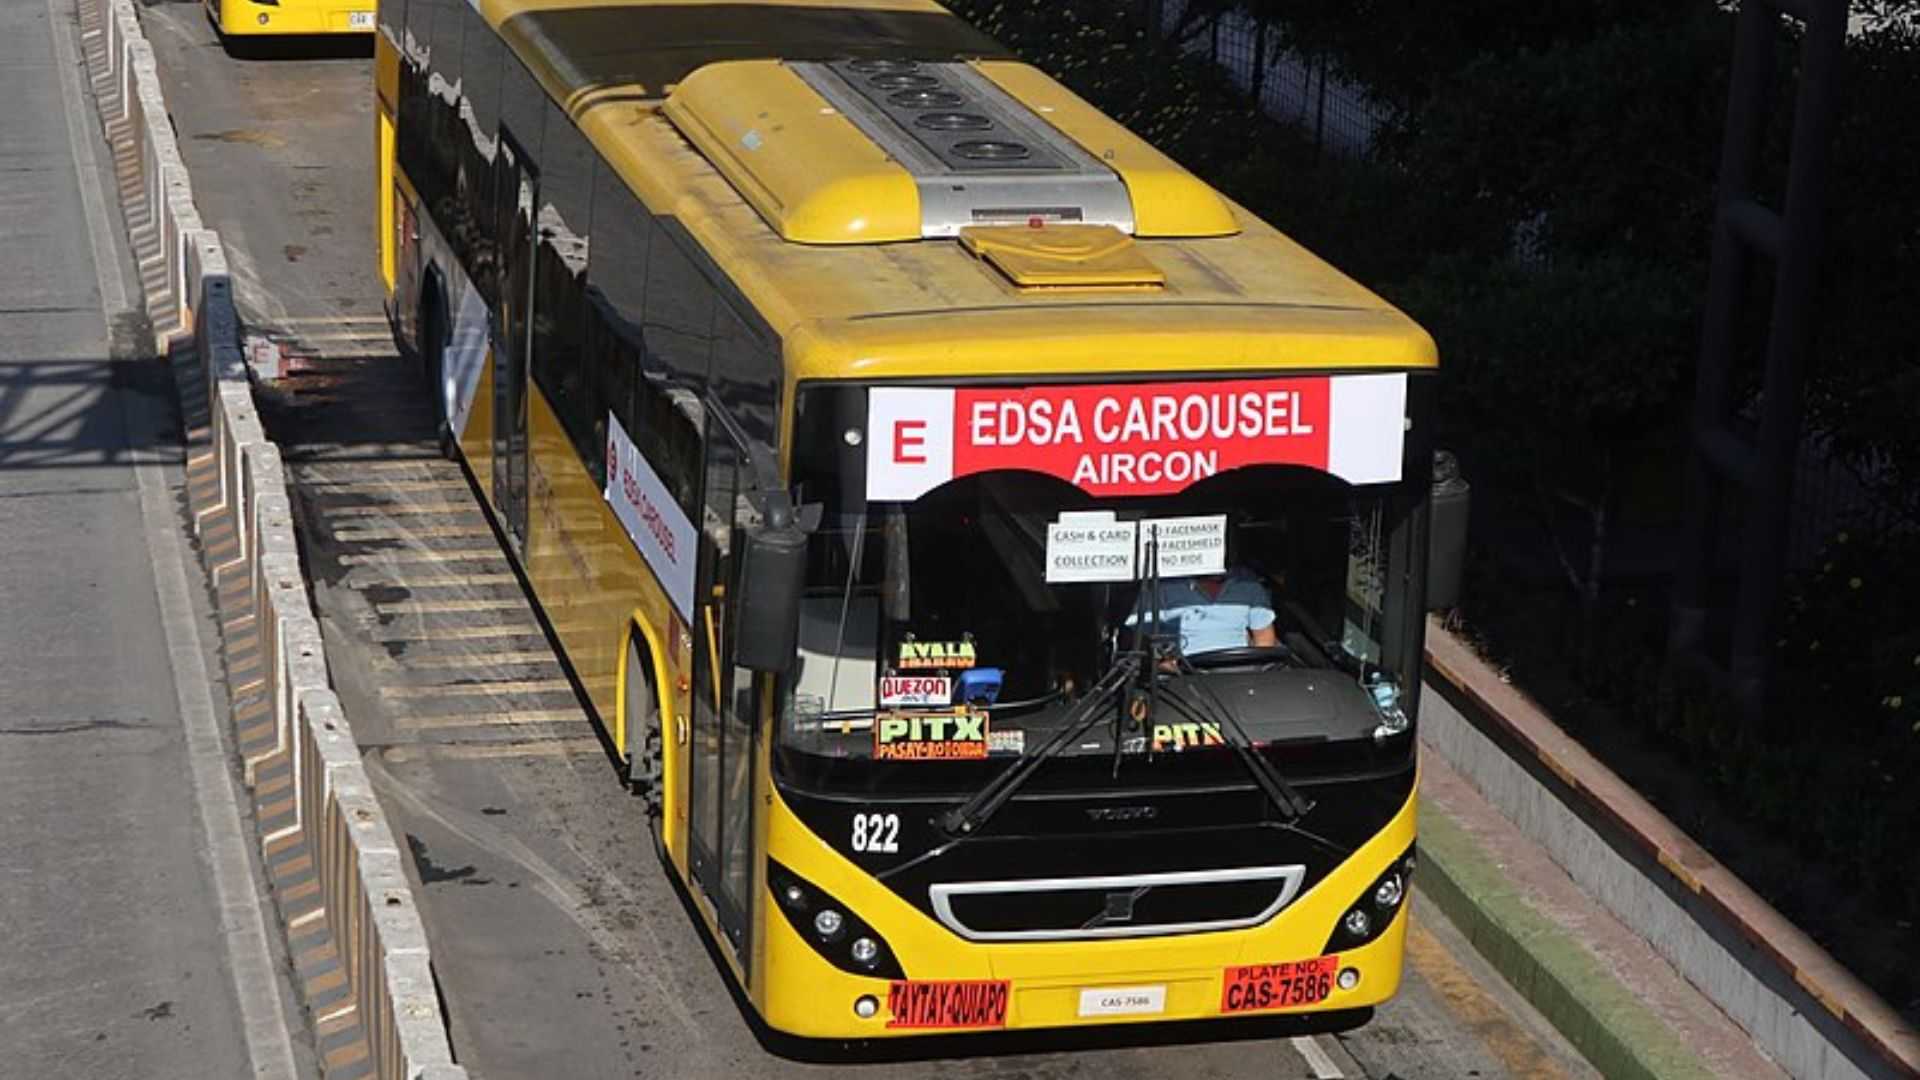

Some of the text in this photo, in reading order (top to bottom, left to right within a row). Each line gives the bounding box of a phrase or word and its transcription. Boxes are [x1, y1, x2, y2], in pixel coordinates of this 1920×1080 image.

[971, 391, 1313, 446] EDSA CAROUSEL
[892, 420, 927, 463] E
[1072, 450, 1217, 485] AIRCON
[1054, 530, 1085, 542] CASH
[1099, 530, 1131, 542] CARD
[1165, 523, 1219, 535] FACEMASK
[1161, 537, 1222, 551] FACESHIELD
[1054, 554, 1129, 568] COLLECTION
[1161, 553, 1203, 566] NO RIDE
[901, 641, 976, 657] AYALA
[882, 679, 946, 698] QUEZON
[880, 717, 984, 743] PITX
[1154, 723, 1224, 747] PITX
[851, 813, 899, 853] 822
[1237, 962, 1290, 981] PLATE
[1227, 972, 1331, 1010] CAS-7586
[891, 983, 1006, 1024] TAYTAY-QUIAPO
